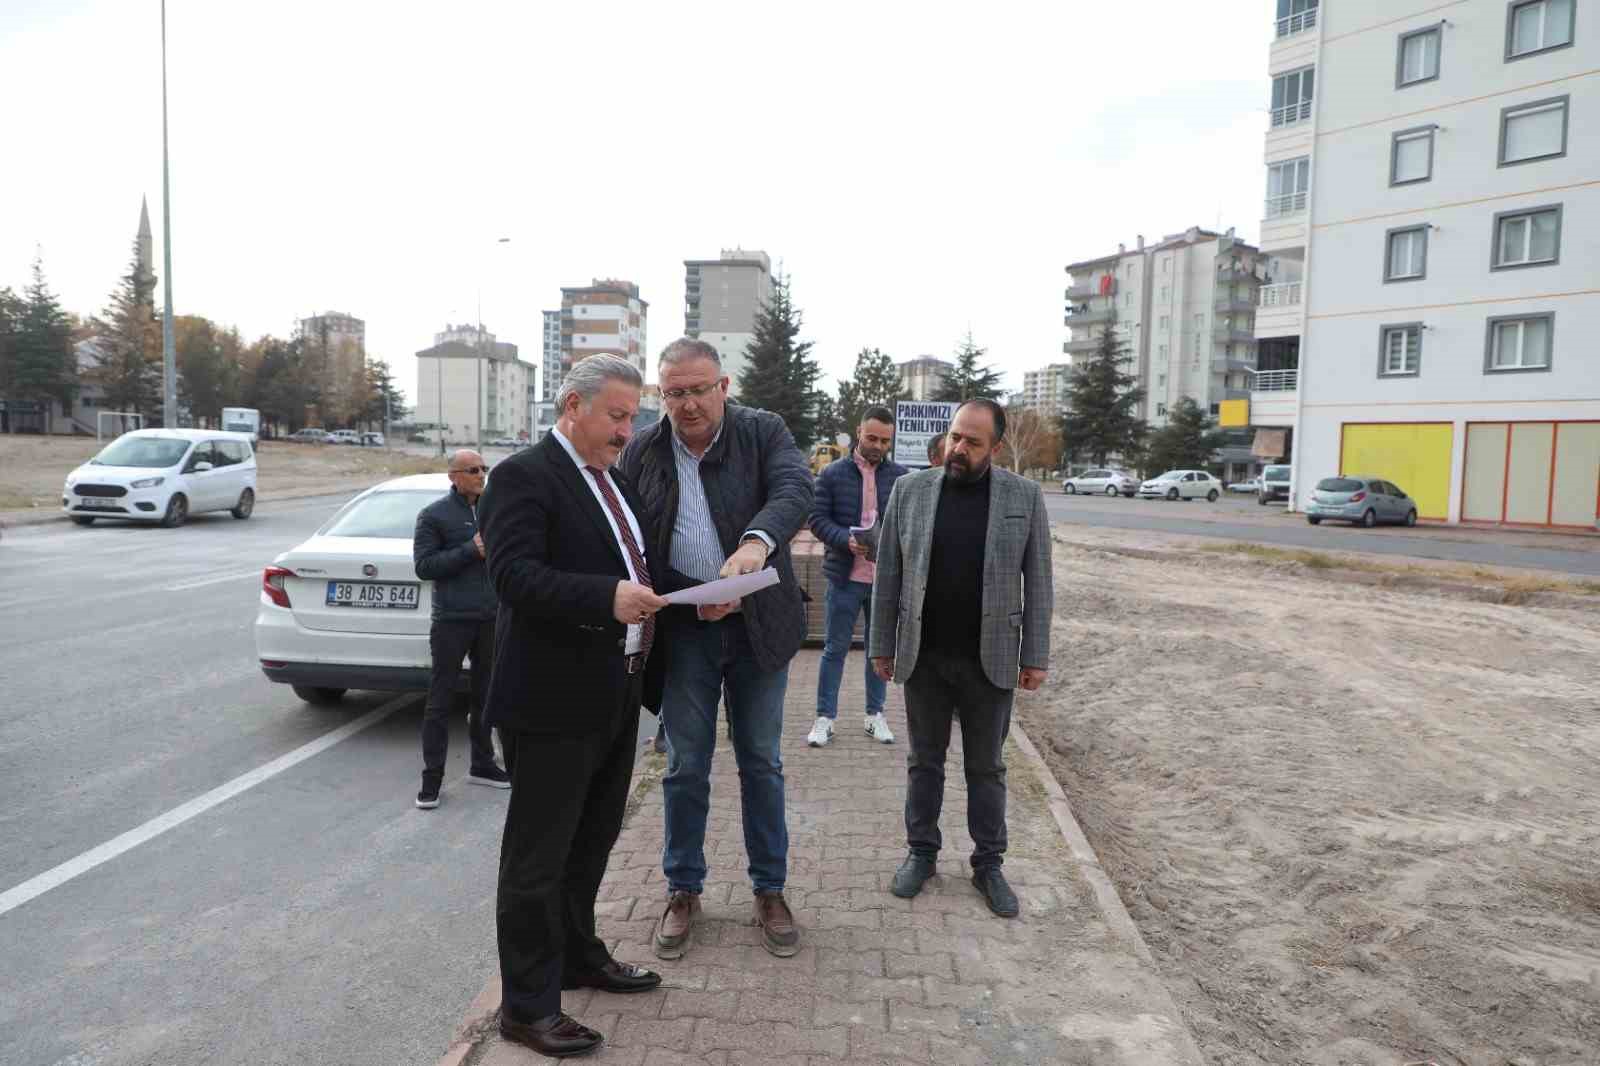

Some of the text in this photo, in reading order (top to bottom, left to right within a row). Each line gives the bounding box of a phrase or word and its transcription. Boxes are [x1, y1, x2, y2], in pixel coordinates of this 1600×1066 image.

[898, 404, 951, 419] PARKIMIZI
[337, 585, 353, 600] 38
[359, 586, 384, 602] ADS
[390, 587, 415, 602] 644
